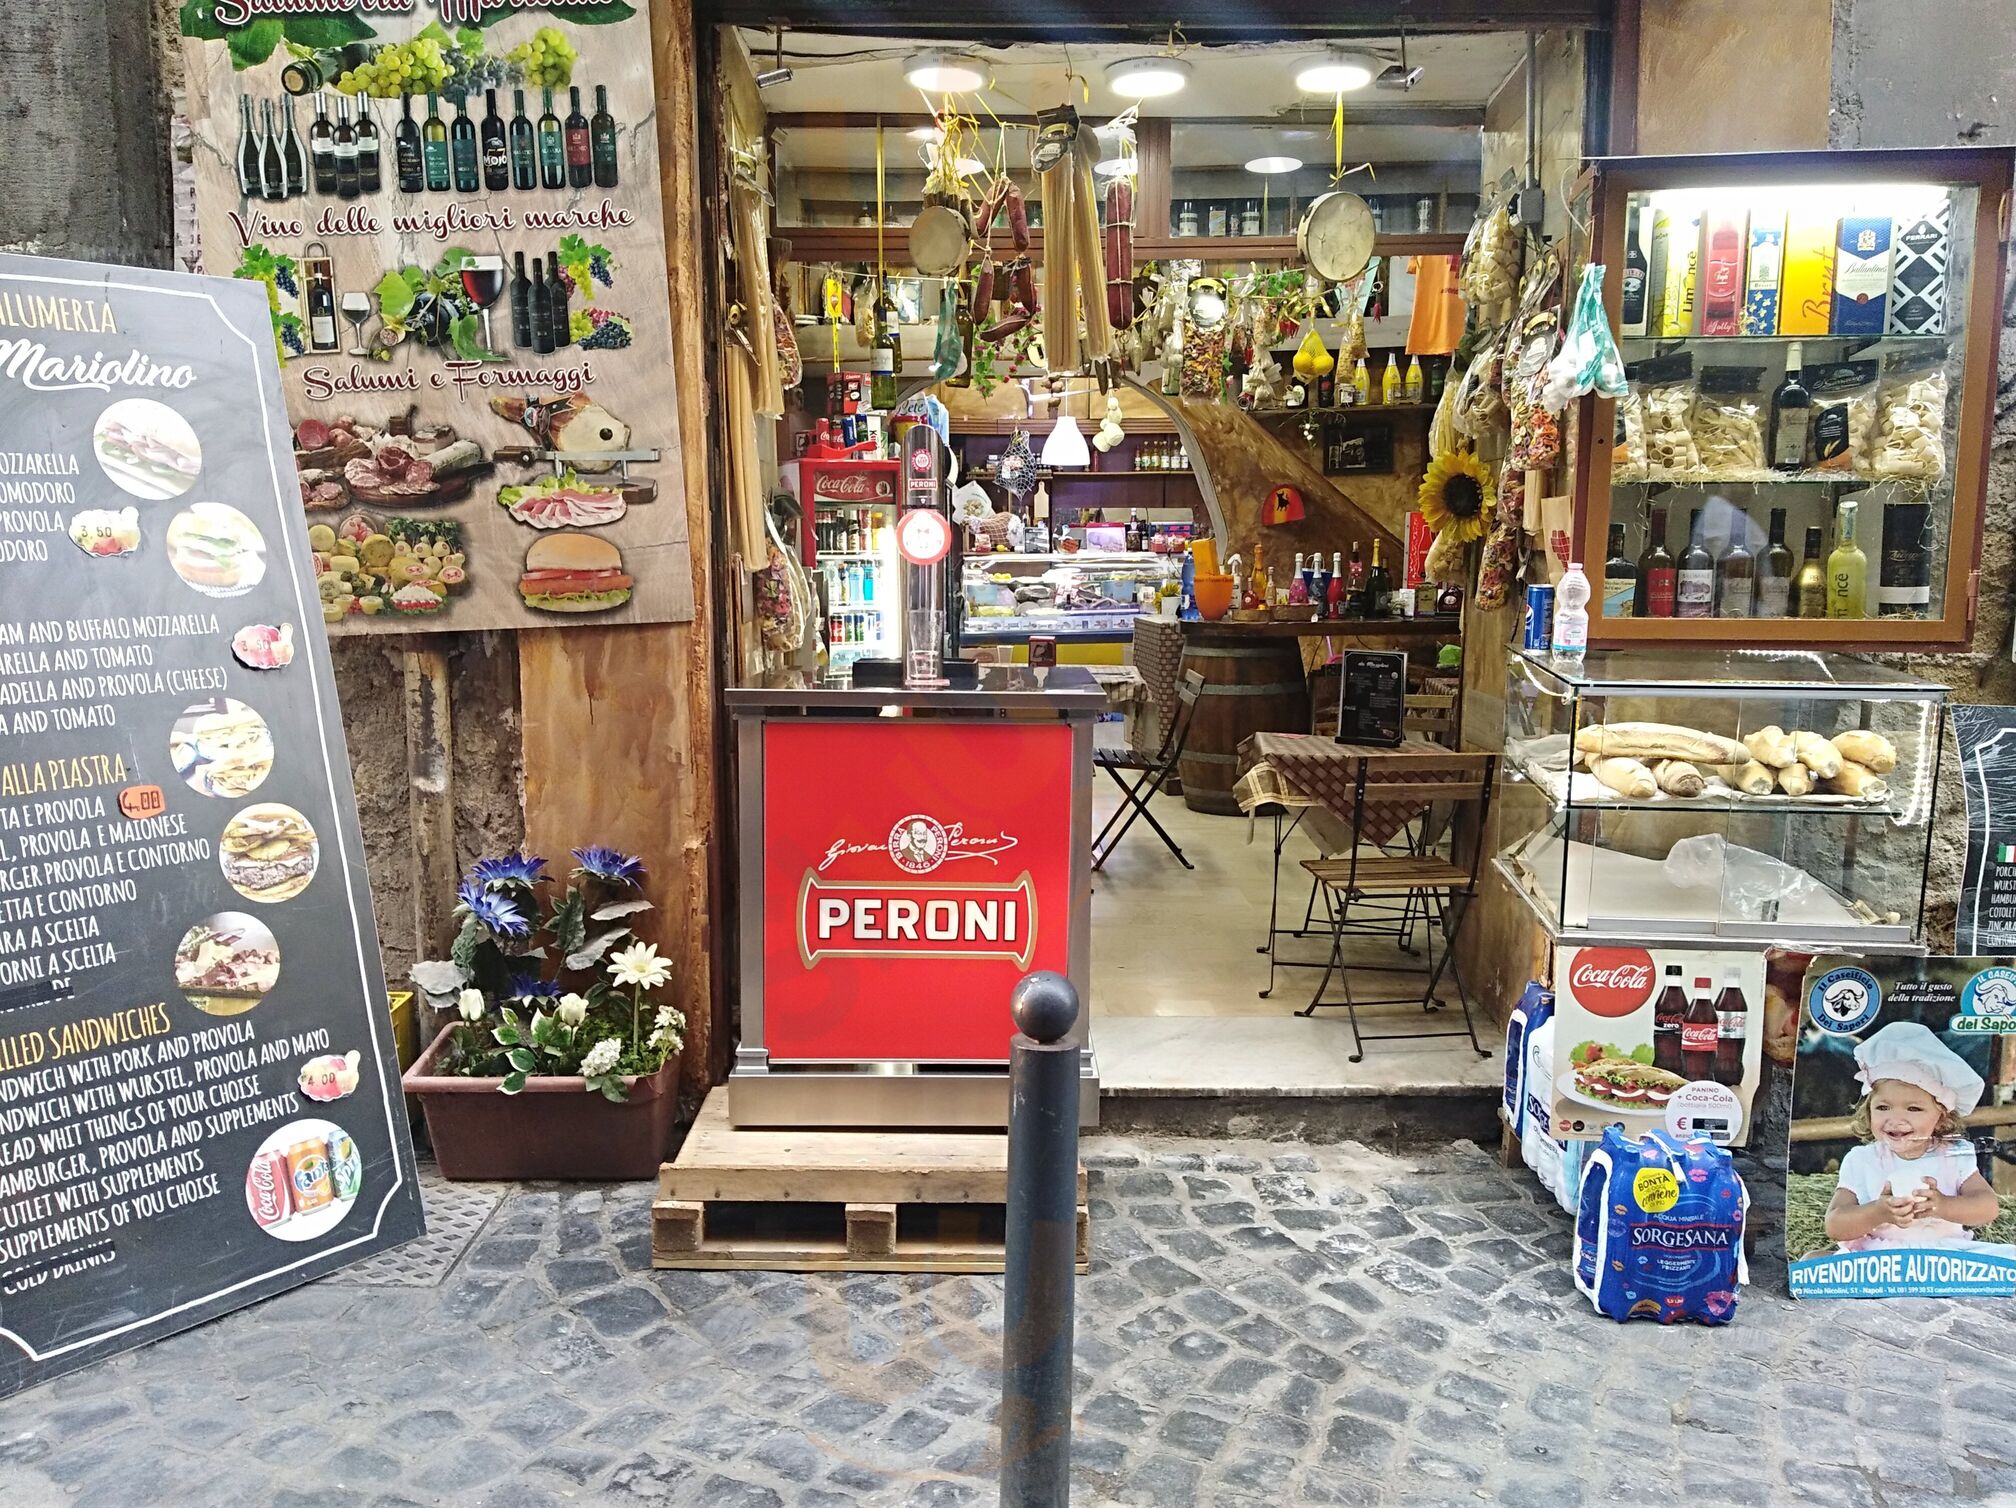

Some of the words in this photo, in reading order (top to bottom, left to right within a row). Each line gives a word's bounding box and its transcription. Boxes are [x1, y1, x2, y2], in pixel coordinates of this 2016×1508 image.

[228, 209, 303, 247] Vino
[316, 206, 383, 236] delle
[395, 205, 515, 244] migliori
[525, 198, 634, 229] marche
[0, 338, 197, 393] Mariolino
[302, 363, 420, 400] Salumi
[429, 371, 445, 388] e
[444, 359, 596, 402] Formaggi
[909, 480, 937, 489] PERONI
[0, 510, 65, 533] ROVOLA
[29, 619, 63, 643] AND
[66, 617, 131, 642] BUFFALO
[132, 613, 220, 639] MOZZARELLA
[55, 647, 88, 671] AND
[90, 644, 153, 669] TOMATO
[62, 676, 95, 700] AND
[98, 670, 164, 697] PROVOLA
[166, 665, 228, 696] (CHEESE)
[13, 710, 48, 734] AND
[51, 703, 116, 731] TOMATO
[2, 762, 47, 797] ALLA
[49, 753, 128, 791] PIASTRA
[23, 804, 33, 827] E
[35, 795, 105, 825] PROVOLA
[20, 827, 91, 859] PROVOLA
[97, 824, 107, 847] E
[109, 813, 187, 844] MAIONESE
[891, 826, 905, 860] BIRRA
[929, 825, 945, 862] PERONI
[45, 852, 114, 885] PROVOLA
[118, 850, 127, 873] E
[128, 837, 211, 871] CONTORNO
[905, 859, 931, 869] 1846
[36, 893, 47, 917] E
[50, 878, 137, 914] CONTORNO
[31, 925, 42, 948] A
[46, 915, 100, 946] SCELTA
[817, 897, 1018, 943] PERONI
[0, 955, 44, 985] ORNI
[49, 952, 60, 976] A
[64, 941, 116, 972] SCELTA
[1827, 970, 1873, 990] Caseificio
[1887, 993, 1910, 1002] della
[1911, 993, 1956, 1003] tradizione
[1894, 981, 1918, 991] Tutto
[1919, 981, 1927, 991] il
[1928, 983, 1953, 993] gusto
[49, 1002, 170, 1060] SANDWICHES
[1817, 1013, 1833, 1029] Dei
[1836, 1014, 1870, 1031] Sapori
[1957, 1017, 1977, 1030] dei
[67, 1055, 112, 1087] WITH
[114, 1045, 154, 1075] PORK
[157, 1037, 190, 1063] AND
[192, 1019, 255, 1055] PROVOLA
[72, 1080, 115, 1115] WITH
[118, 1067, 194, 1103] WURSTEL,
[195, 1047, 257, 1084] PROVOLA
[260, 1038, 290, 1065] AND
[292, 1027, 330, 1056] MAYO
[38, 1122, 82, 1155] WHIT
[85, 1107, 146, 1141] THINGS
[148, 1100, 166, 1124] OF
[165, 1089, 208, 1119] YOUR
[210, 1074, 262, 1107] CHOISE
[1686, 1093, 1733, 1102] Coca-Cola
[98, 1130, 168, 1170] PROVOLA
[170, 1121, 204, 1150] AND
[206, 1091, 300, 1140] SUPPLEMENTS
[54, 1179, 100, 1213] WITH
[102, 1148, 205, 1201] SUPPLEMENTS
[111, 1202, 131, 1228] OF
[131, 1194, 165, 1223] YOU
[165, 1172, 221, 1211] CHOISE
[1632, 1227, 1729, 1248] SORGESANA
[1791, 1255, 1902, 1284] RIVENDITORE
[1905, 1255, 2016, 1282] AUTORIZZATO
[1863, 1287, 1884, 1296] Napoli
